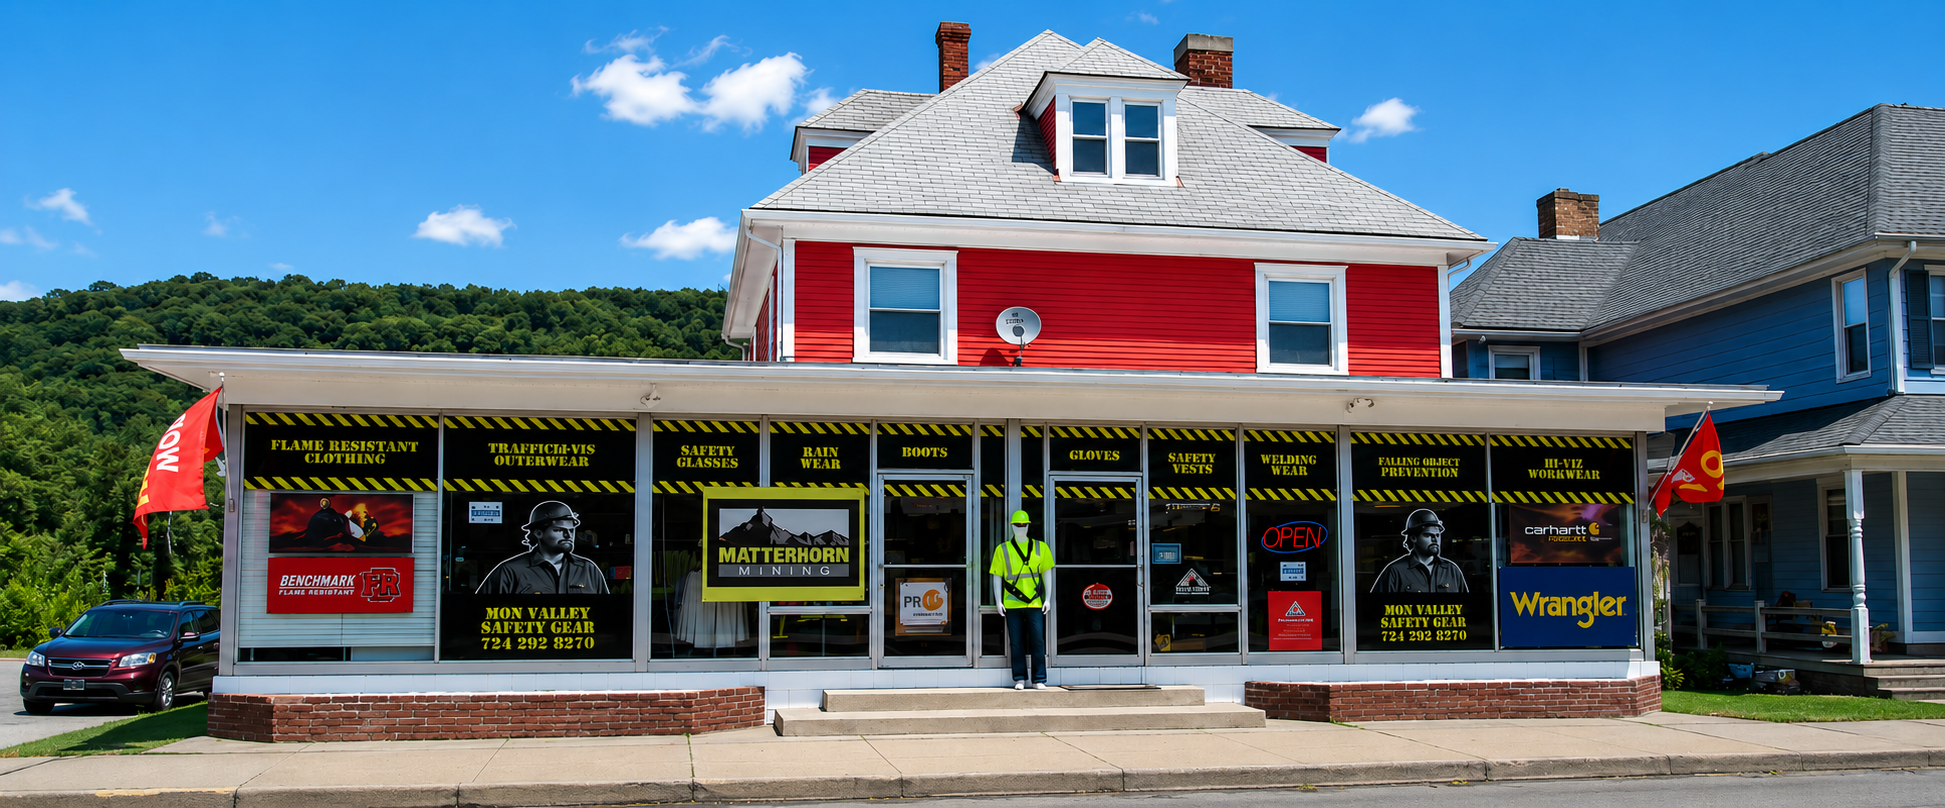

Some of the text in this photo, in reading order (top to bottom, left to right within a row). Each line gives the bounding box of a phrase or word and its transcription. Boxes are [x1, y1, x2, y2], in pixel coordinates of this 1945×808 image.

[272, 440, 418, 452] FLAME RESISTANT
[681, 445, 734, 456] SAFETY
[803, 447, 838, 457] RAIN
[903, 447, 947, 457] BOOTS
[1070, 450, 1119, 460] GLOVES
[305, 453, 385, 464] CLOTHING
[495, 455, 589, 466] OUTERWEAR
[677, 457, 738, 468] GLASSES
[801, 458, 840, 469] WEAR
[1168, 453, 1215, 463] SAFETY
[1261, 455, 1316, 464] WELDING
[1379, 457, 1419, 466] FALLING
[1173, 464, 1212, 474] VESTS
[1271, 466, 1307, 475] WEAR
[1382, 467, 1458, 477] PREVENTION
[1528, 469, 1600, 479] WORKWEAR
[1524, 525, 1586, 535] carhartt
[1263, 526, 1321, 548] OPEN
[719, 548, 849, 562] MATTERHORN
[738, 565, 830, 576] MINING
[280, 575, 356, 587] BENCHMARK
[486, 607, 590, 619] MON VALLEY
[1385, 605, 1462, 615] MON VALLEY
[1510, 592, 1625, 628] Wrangler
[481, 621, 594, 634] SAFETY GEAR
[1381, 617, 1466, 628] SAFETY GEAR
[1382, 630, 1466, 641] 724 292 8270
[482, 637, 594, 649] 724 292 8270
